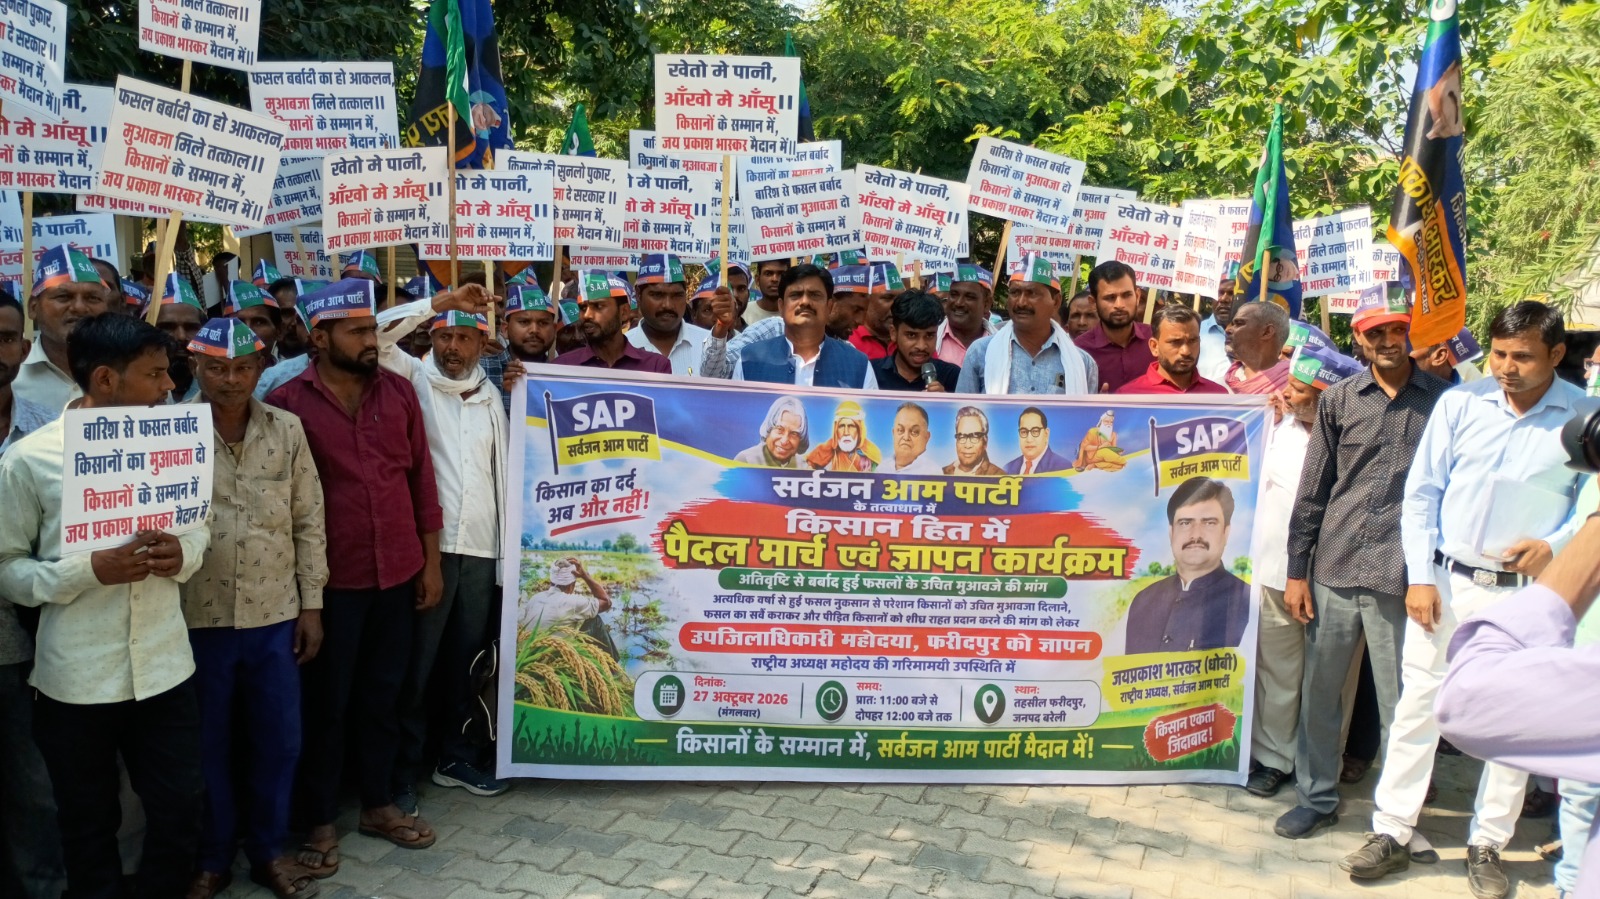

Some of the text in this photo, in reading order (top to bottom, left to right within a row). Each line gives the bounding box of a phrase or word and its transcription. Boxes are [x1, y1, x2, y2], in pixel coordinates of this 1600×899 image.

[732, 62, 777, 83] पानी,
[118, 88, 155, 112] फसल
[156, 99, 190, 122] बर्बादी
[192, 108, 212, 128] का
[213, 112, 228, 132] हो
[174, 132, 206, 158] मिले
[990, 145, 1014, 160] बारिश
[1015, 150, 1024, 162] से
[1024, 154, 1048, 170] फसल
[979, 158, 1012, 178] किसानों
[1012, 170, 1024, 181] का
[1062, 181, 1072, 194] दो
[980, 179, 1062, 210] किसानों के सम्मान में
[328, 295, 344, 306] आम
[347, 291, 364, 303] पार्टी
[83, 411, 198, 441] बारिश से फसल बर्बाद
[571, 398, 636, 432] SAP
[567, 435, 649, 457] सर्वजन आम पार्टी
[1175, 423, 1228, 455] SAP
[74, 449, 123, 476] किसानों
[126, 452, 146, 470] का
[195, 442, 206, 464] दो
[1169, 456, 1242, 479] सर्वजन आम पार्टी
[83, 476, 199, 512] किसानों के सम्मान में
[535, 468, 636, 503] किसान का दर्द
[772, 470, 1023, 506] सर्वजन आम पार्टी
[547, 488, 650, 524] अब और नहीं!
[854, 500, 867, 512] के
[926, 502, 937, 514] में
[65, 522, 88, 544] जय
[92, 516, 133, 540] प्रकाश
[176, 504, 199, 526] मैदान
[200, 500, 210, 520] में
[785, 508, 1011, 543] किसान हित में
[663, 519, 1127, 577] पैदल मार्च एवं ज्ञापन कार्यक्रम
[738, 572, 1048, 595] अतिवृष्टि से बर्बाद हुई फसलों के उचित मुआवजे की मांग
[714, 593, 1071, 614] अत्यधिक वर्षा से हुई फसल नुकसान से परेशान किसानों को उचित मुआवजा दिलाने,
[690, 628, 1092, 655] उपजिलाधिकारी महोदया, फरीदपुर को ज्ञापन
[751, 655, 1016, 673] राष्ट्रीय अध्यक्ष महोदय की गरिमामयी उपस्थिति में
[1112, 664, 1163, 686] जयप्रकाश
[1204, 652, 1237, 674] (धोबी)
[693, 691, 788, 706] 27 अक्टूबर 2026
[880, 696, 908, 705] 11:00
[911, 694, 928, 706] बजे
[930, 694, 938, 706] से
[1014, 697, 1086, 711] तहसील फरीदपुर,
[1120, 674, 1230, 704] राष्ट्रीय अध्यक्ष, सर्वजन आम पार्टी
[718, 707, 760, 720] (मंगलवार)
[855, 709, 952, 722] दोपहर 12:00 बजे तक
[1012, 712, 1066, 723] जनपद बरेली
[1155, 709, 1216, 739] किसान एकता
[676, 726, 1094, 760] किसानों के सम्मान में, सर्वजन आम पार्टी मैदान में!
